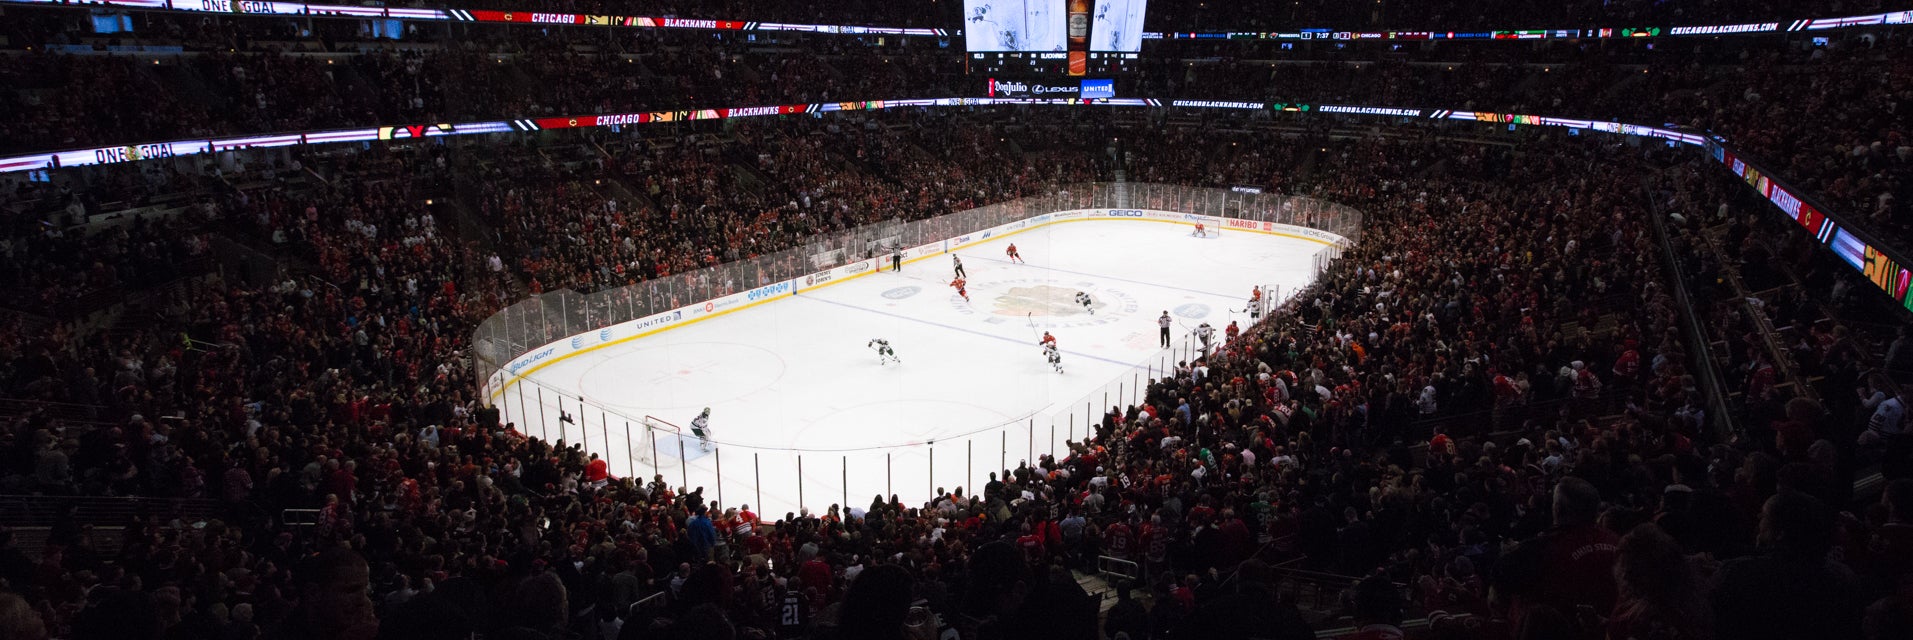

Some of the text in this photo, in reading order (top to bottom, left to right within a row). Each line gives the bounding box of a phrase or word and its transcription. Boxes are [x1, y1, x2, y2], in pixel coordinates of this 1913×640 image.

[202, 0, 276, 13] ONE GOAL
[532, 13, 575, 24] CHICAGO
[664, 18, 717, 29] BLACKHAWKS
[1671, 22, 1779, 35] CHICAGOBLACKHAWKS.COM
[1172, 99, 1264, 109] CHICAGOBLACKHAWKS.COM
[727, 105, 780, 118] BLACKHAWKS
[1319, 105, 1421, 117] CHICAGOBLACKHAWKS.COM
[596, 113, 640, 126] CHICAGO
[95, 143, 173, 164] ONE GOAL
[1108, 209, 1143, 217] GEICO
[1229, 219, 1258, 229] HARIBO
[637, 315, 672, 330] UNITED
[529, 347, 554, 363] LIGHT
[781, 604, 799, 625] 21
